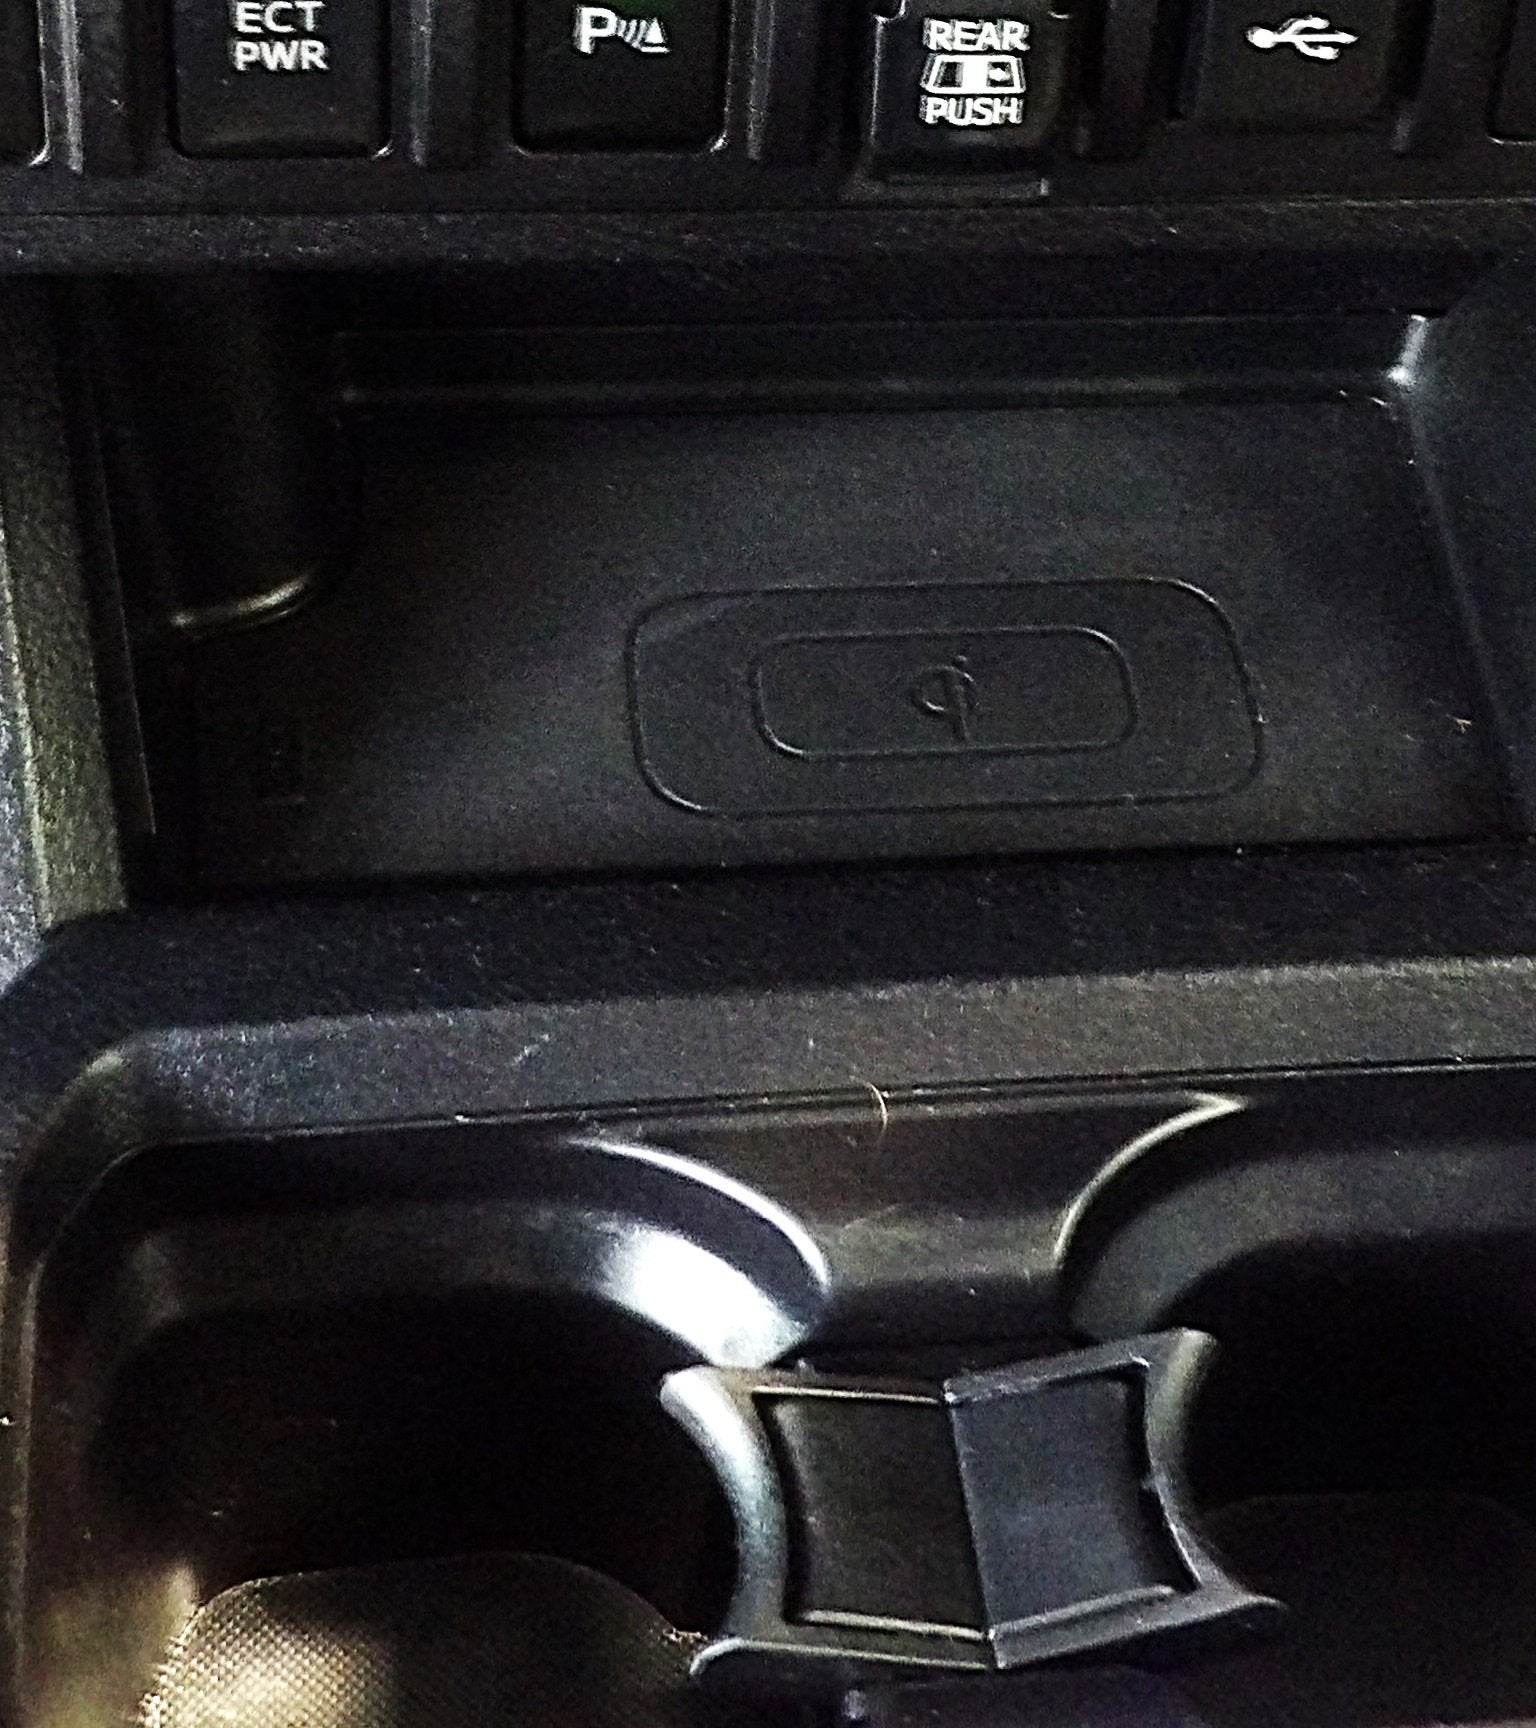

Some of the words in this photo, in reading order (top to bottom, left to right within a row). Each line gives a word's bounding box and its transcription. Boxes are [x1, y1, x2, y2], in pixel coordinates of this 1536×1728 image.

[232, 0, 324, 34] ECT
[924, 18, 1030, 52] REAR
[232, 40, 328, 72] PWR
[923, 96, 1023, 126] PUSH
